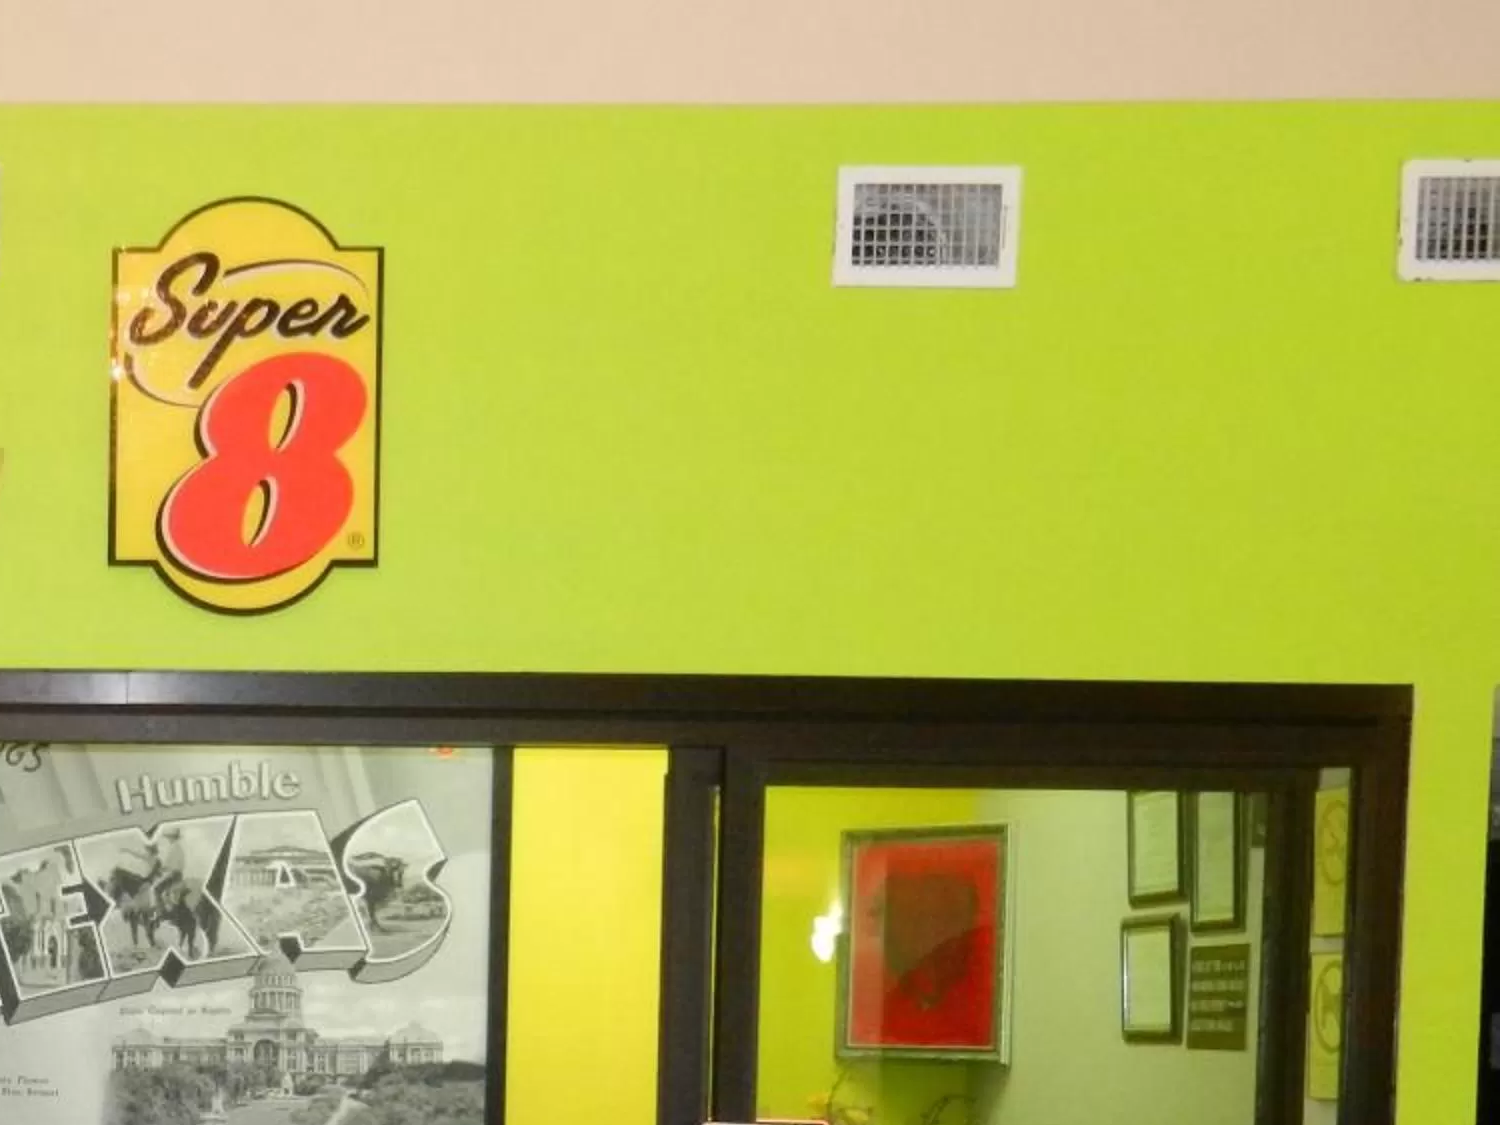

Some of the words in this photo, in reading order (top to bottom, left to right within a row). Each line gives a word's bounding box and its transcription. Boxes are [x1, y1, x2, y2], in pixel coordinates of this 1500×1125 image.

[129, 251, 370, 390] Super
[155, 351, 368, 585] 8
[115, 759, 301, 815] Humble
